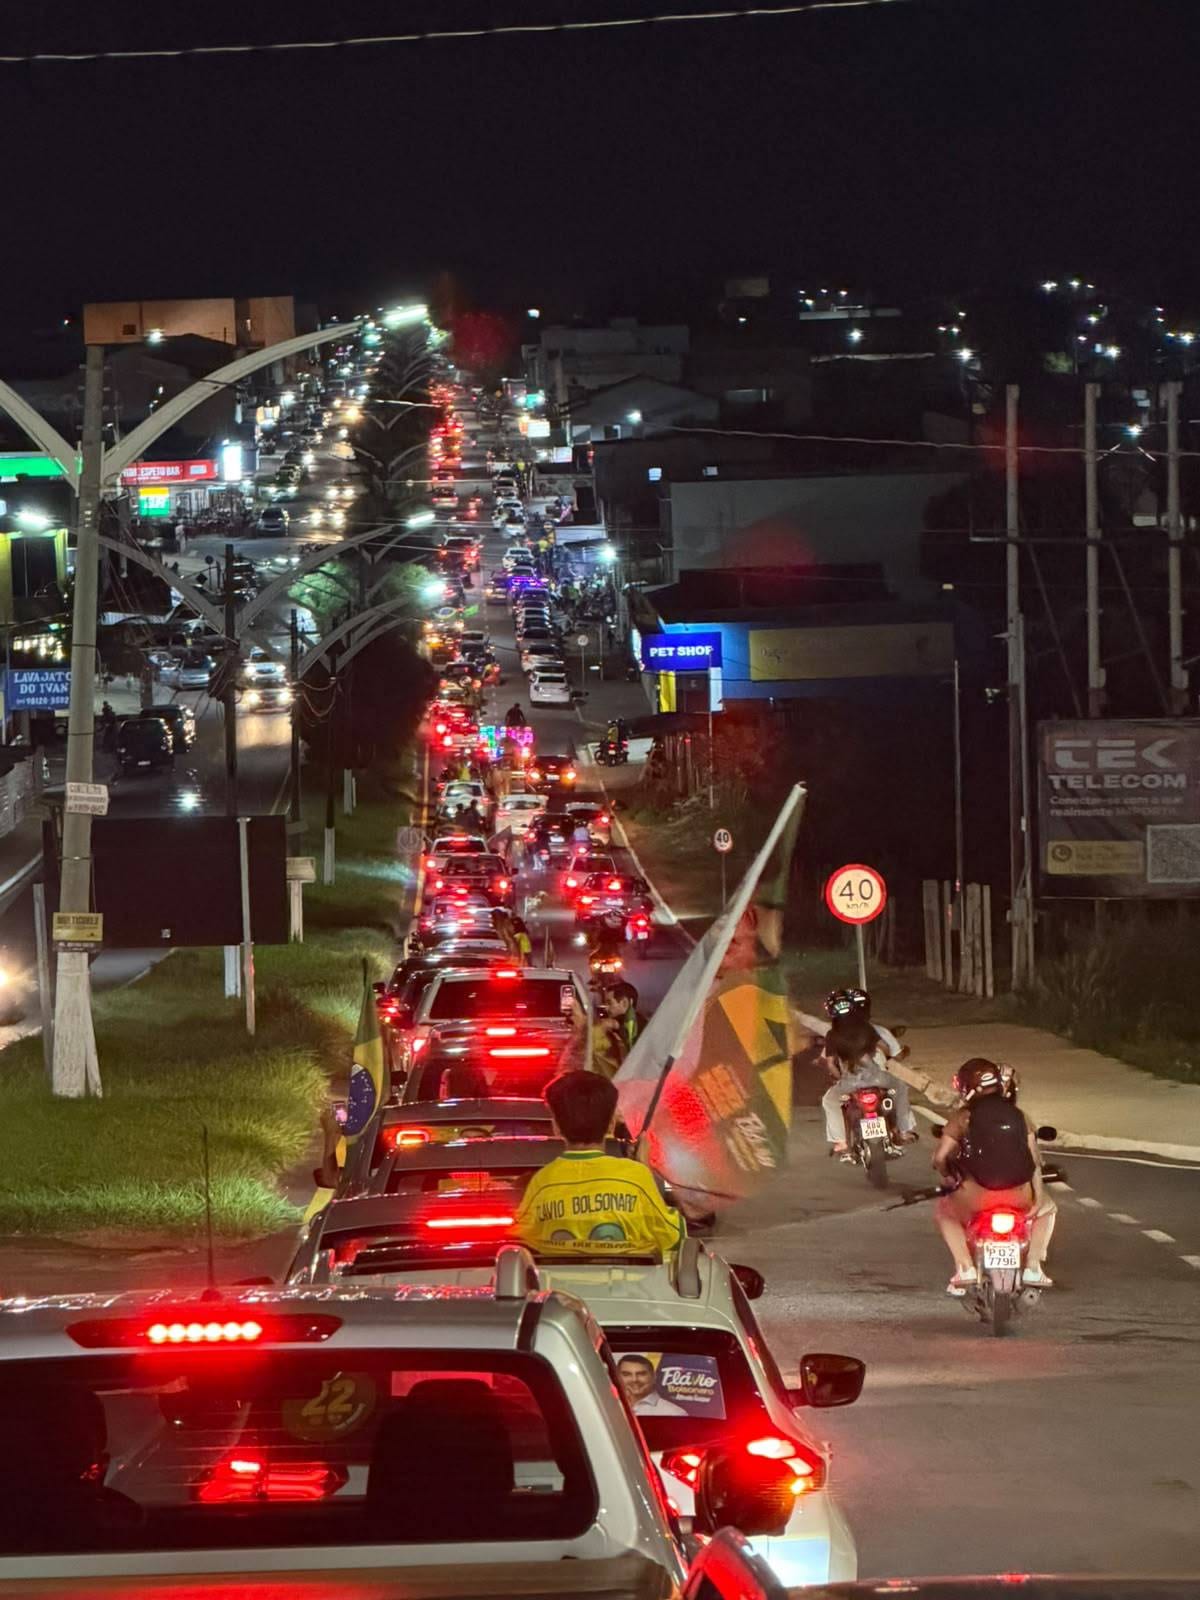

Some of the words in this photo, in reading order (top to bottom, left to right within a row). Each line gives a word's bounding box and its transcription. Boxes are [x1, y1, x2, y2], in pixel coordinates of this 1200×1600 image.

[650, 647, 675, 657] PET
[677, 645, 713, 657] SHOP
[20, 683, 36, 694] DO
[40, 682, 69, 693] IVAN
[1048, 773, 1187, 789] TELECOM
[716, 831, 729, 843] 40
[839, 878, 874, 902] 40
[989, 1257, 1017, 1266] 7796
[661, 1366, 718, 1388] Flávio
[301, 1379, 356, 1416] 22
